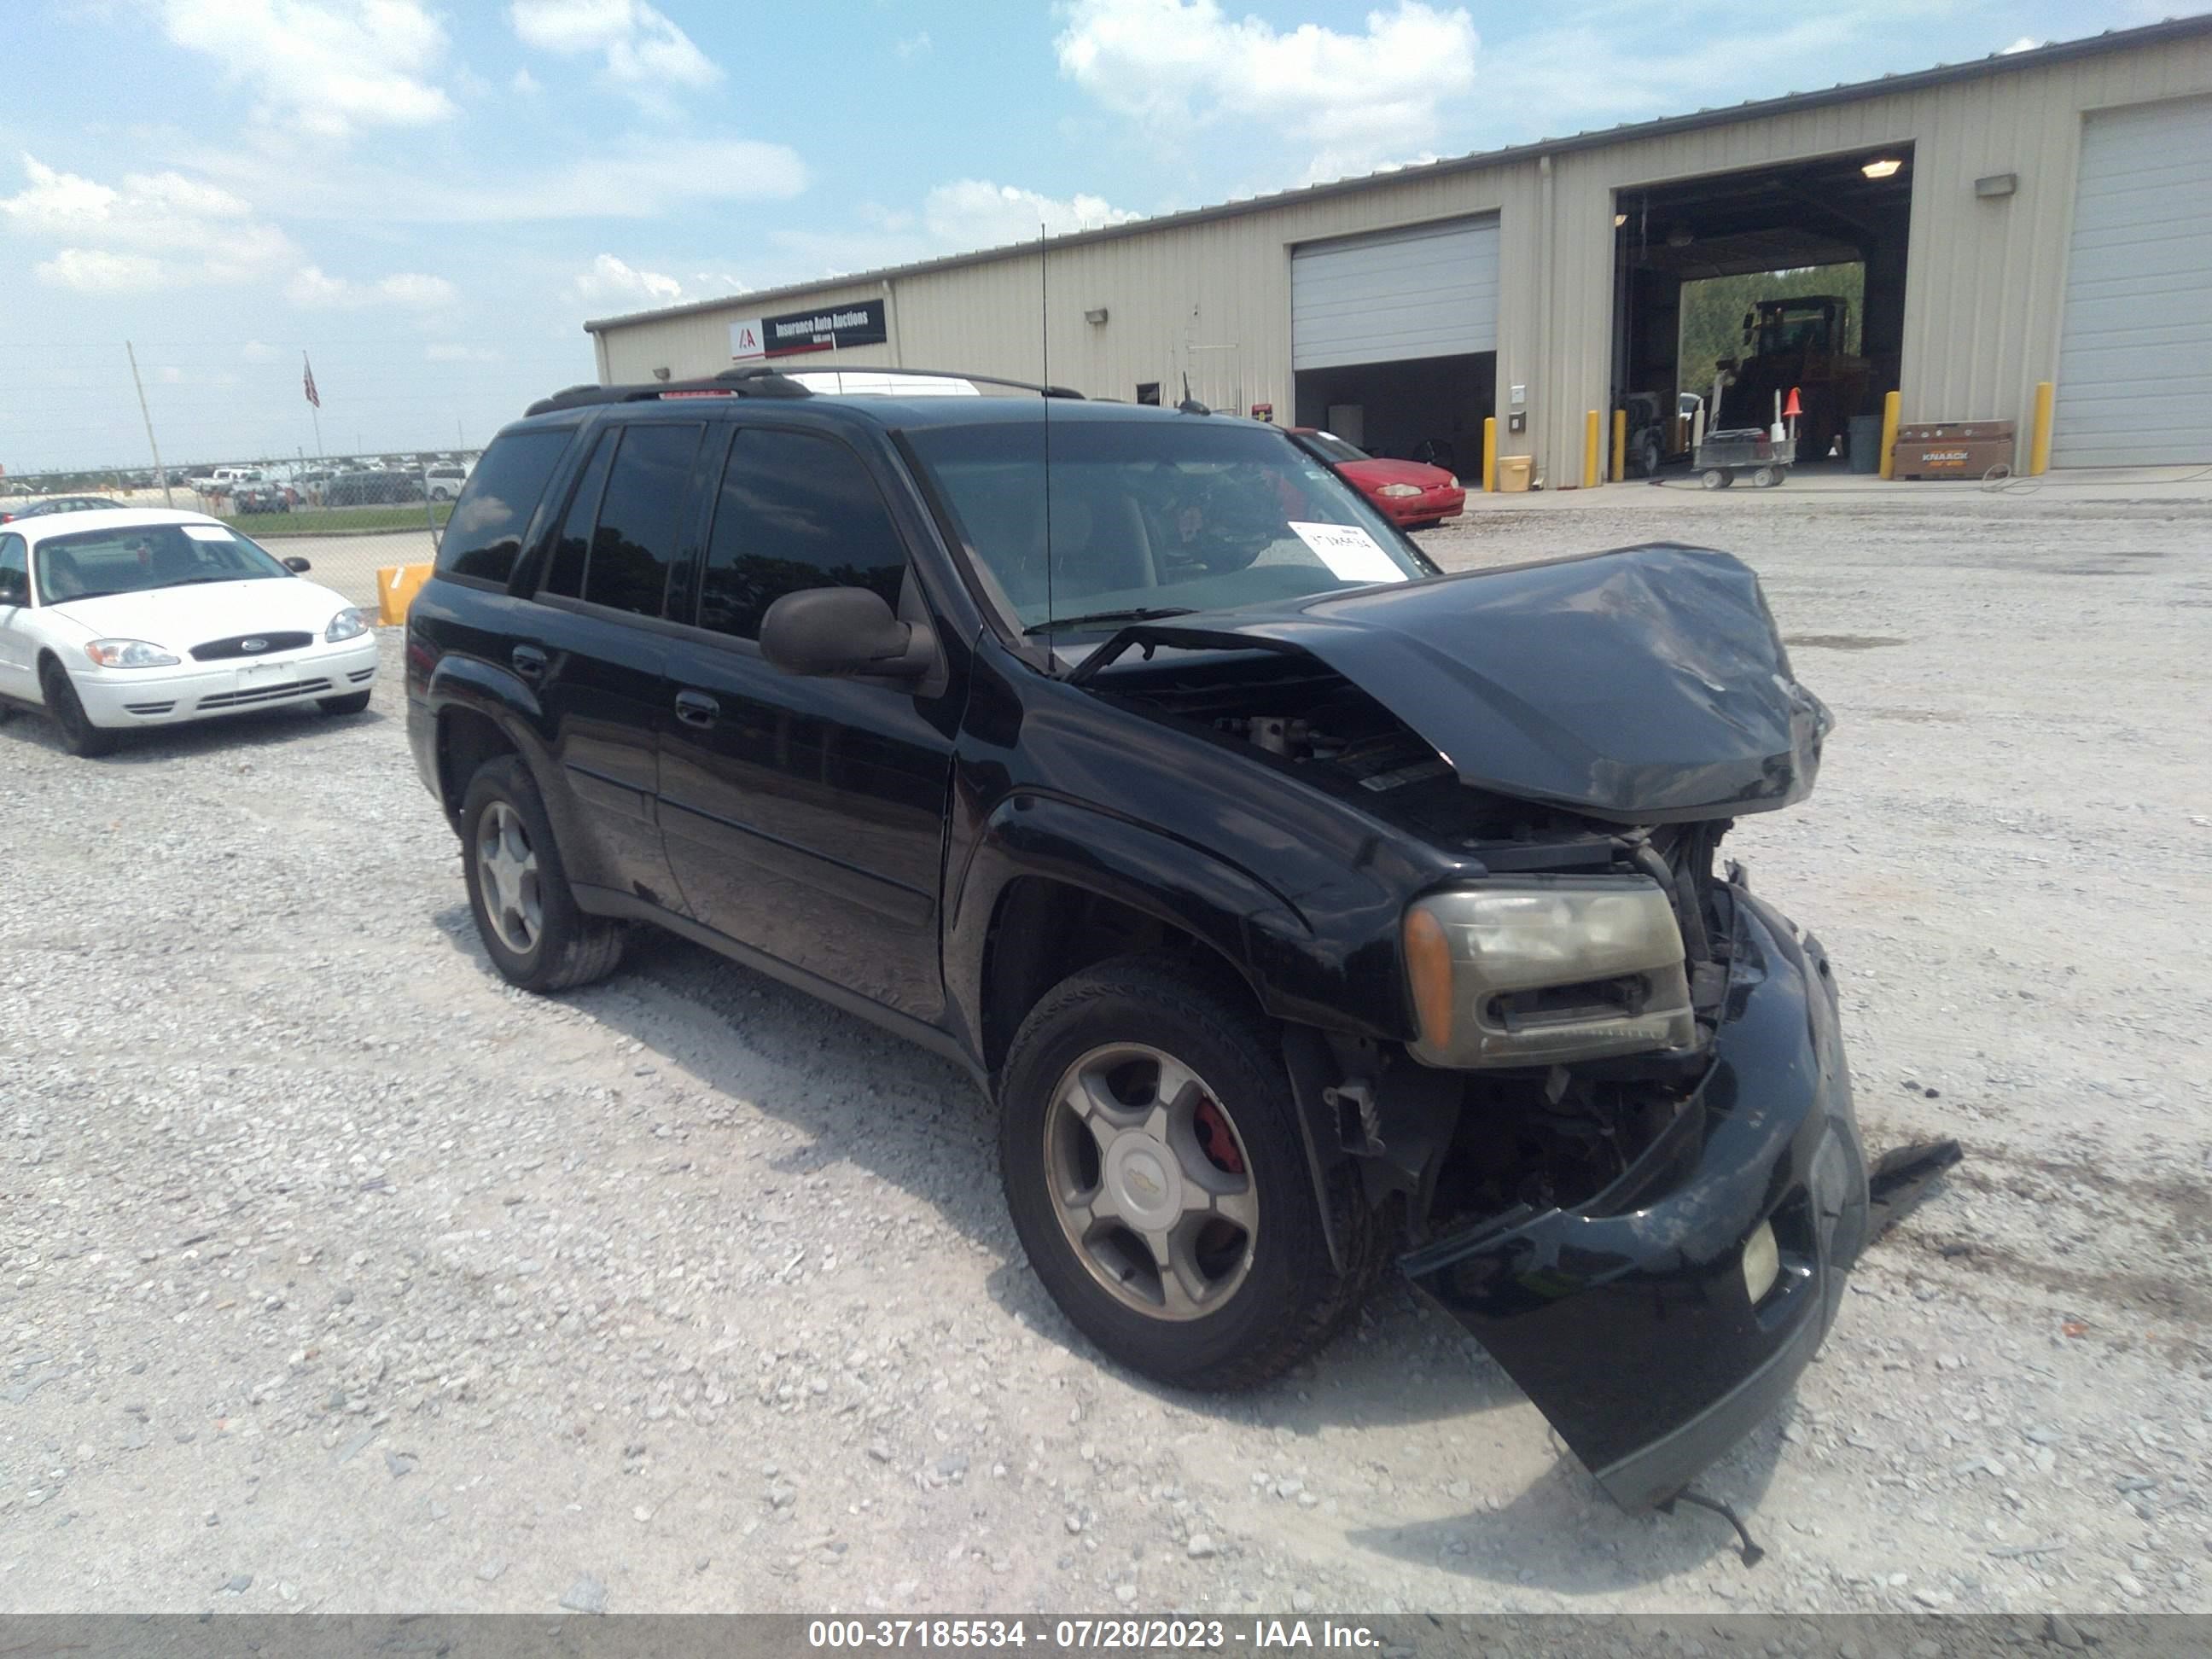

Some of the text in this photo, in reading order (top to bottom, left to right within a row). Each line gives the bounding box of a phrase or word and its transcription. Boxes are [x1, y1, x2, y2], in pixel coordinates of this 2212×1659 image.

[776, 310, 869, 338] Insurance Auto Auctions
